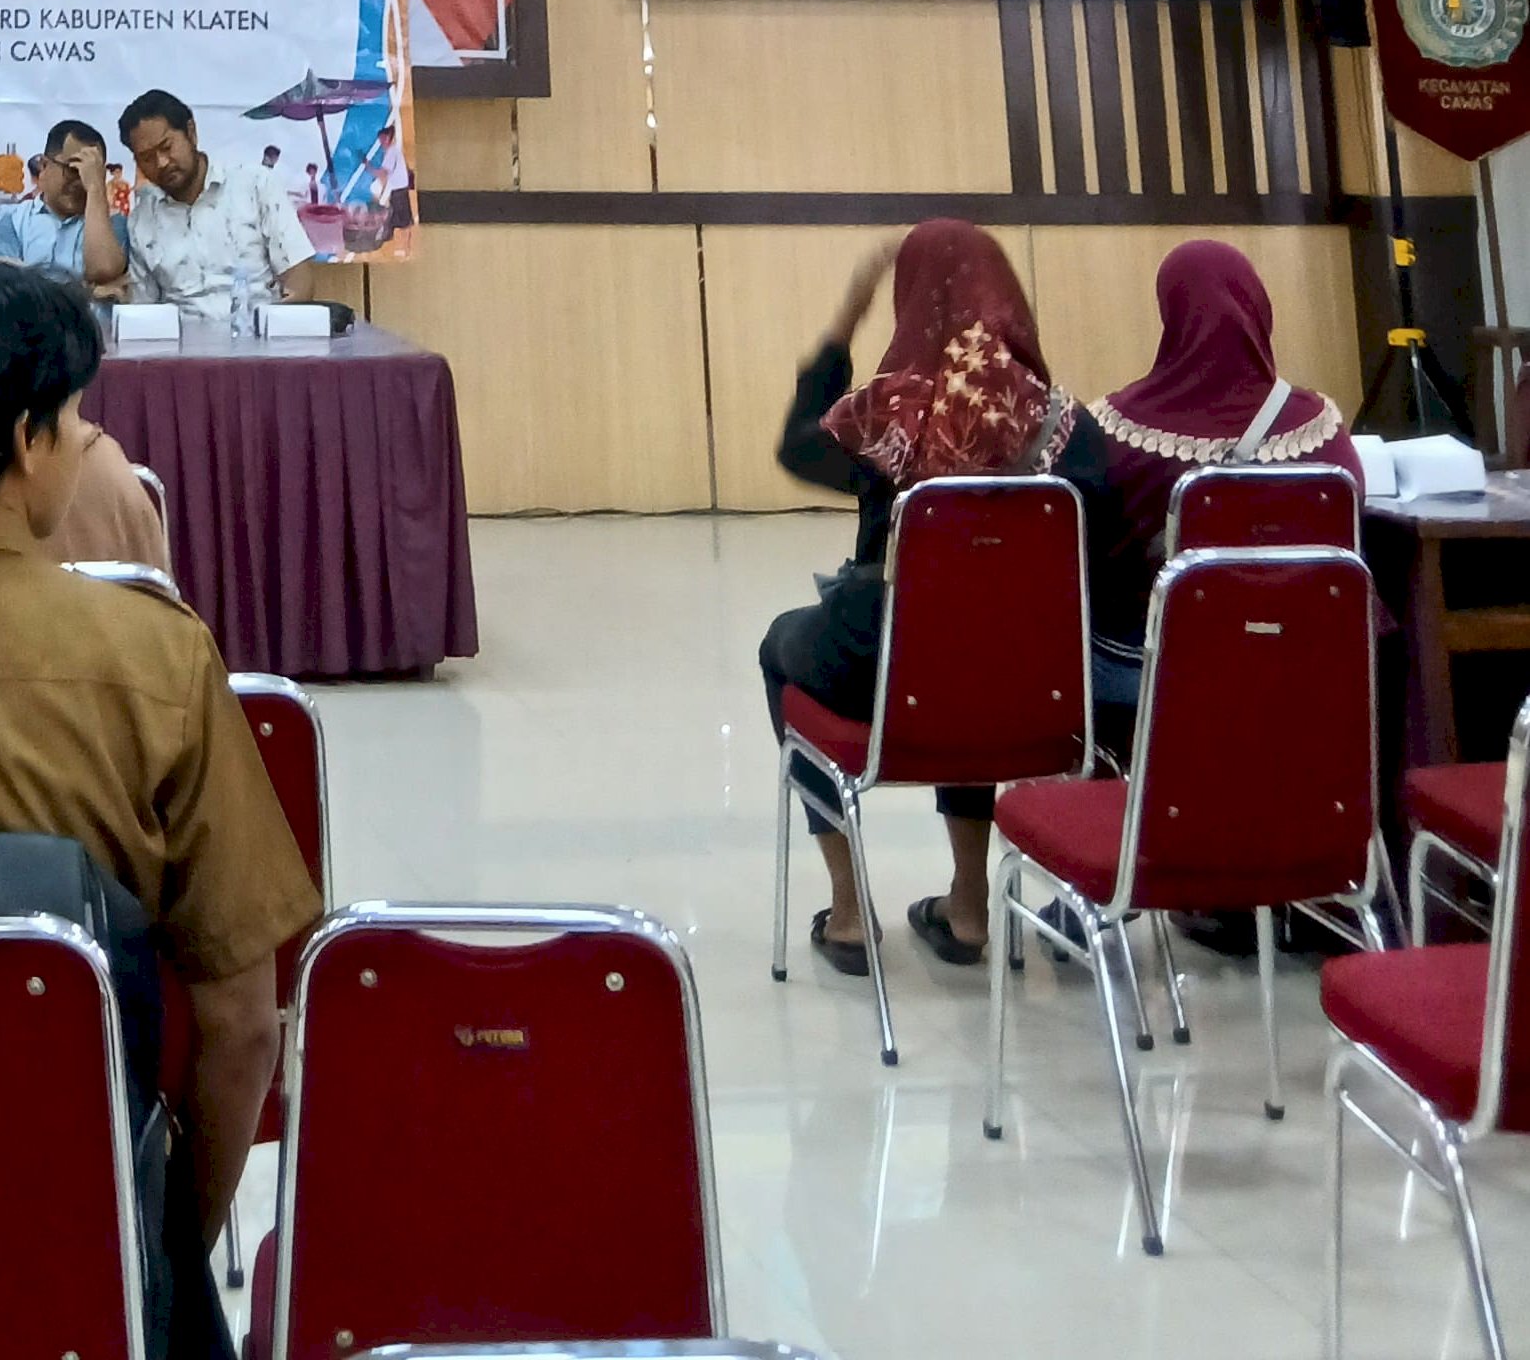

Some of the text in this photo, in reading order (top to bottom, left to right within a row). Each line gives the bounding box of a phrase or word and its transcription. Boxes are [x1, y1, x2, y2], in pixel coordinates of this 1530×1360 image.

[39, 8, 174, 30] KABUPATEN
[182, 9, 269, 31] KLATEN
[10, 40, 96, 63] CAWAS
[1418, 78, 1511, 95] KECAMATAN
[1440, 95, 1494, 111] CAWAS
